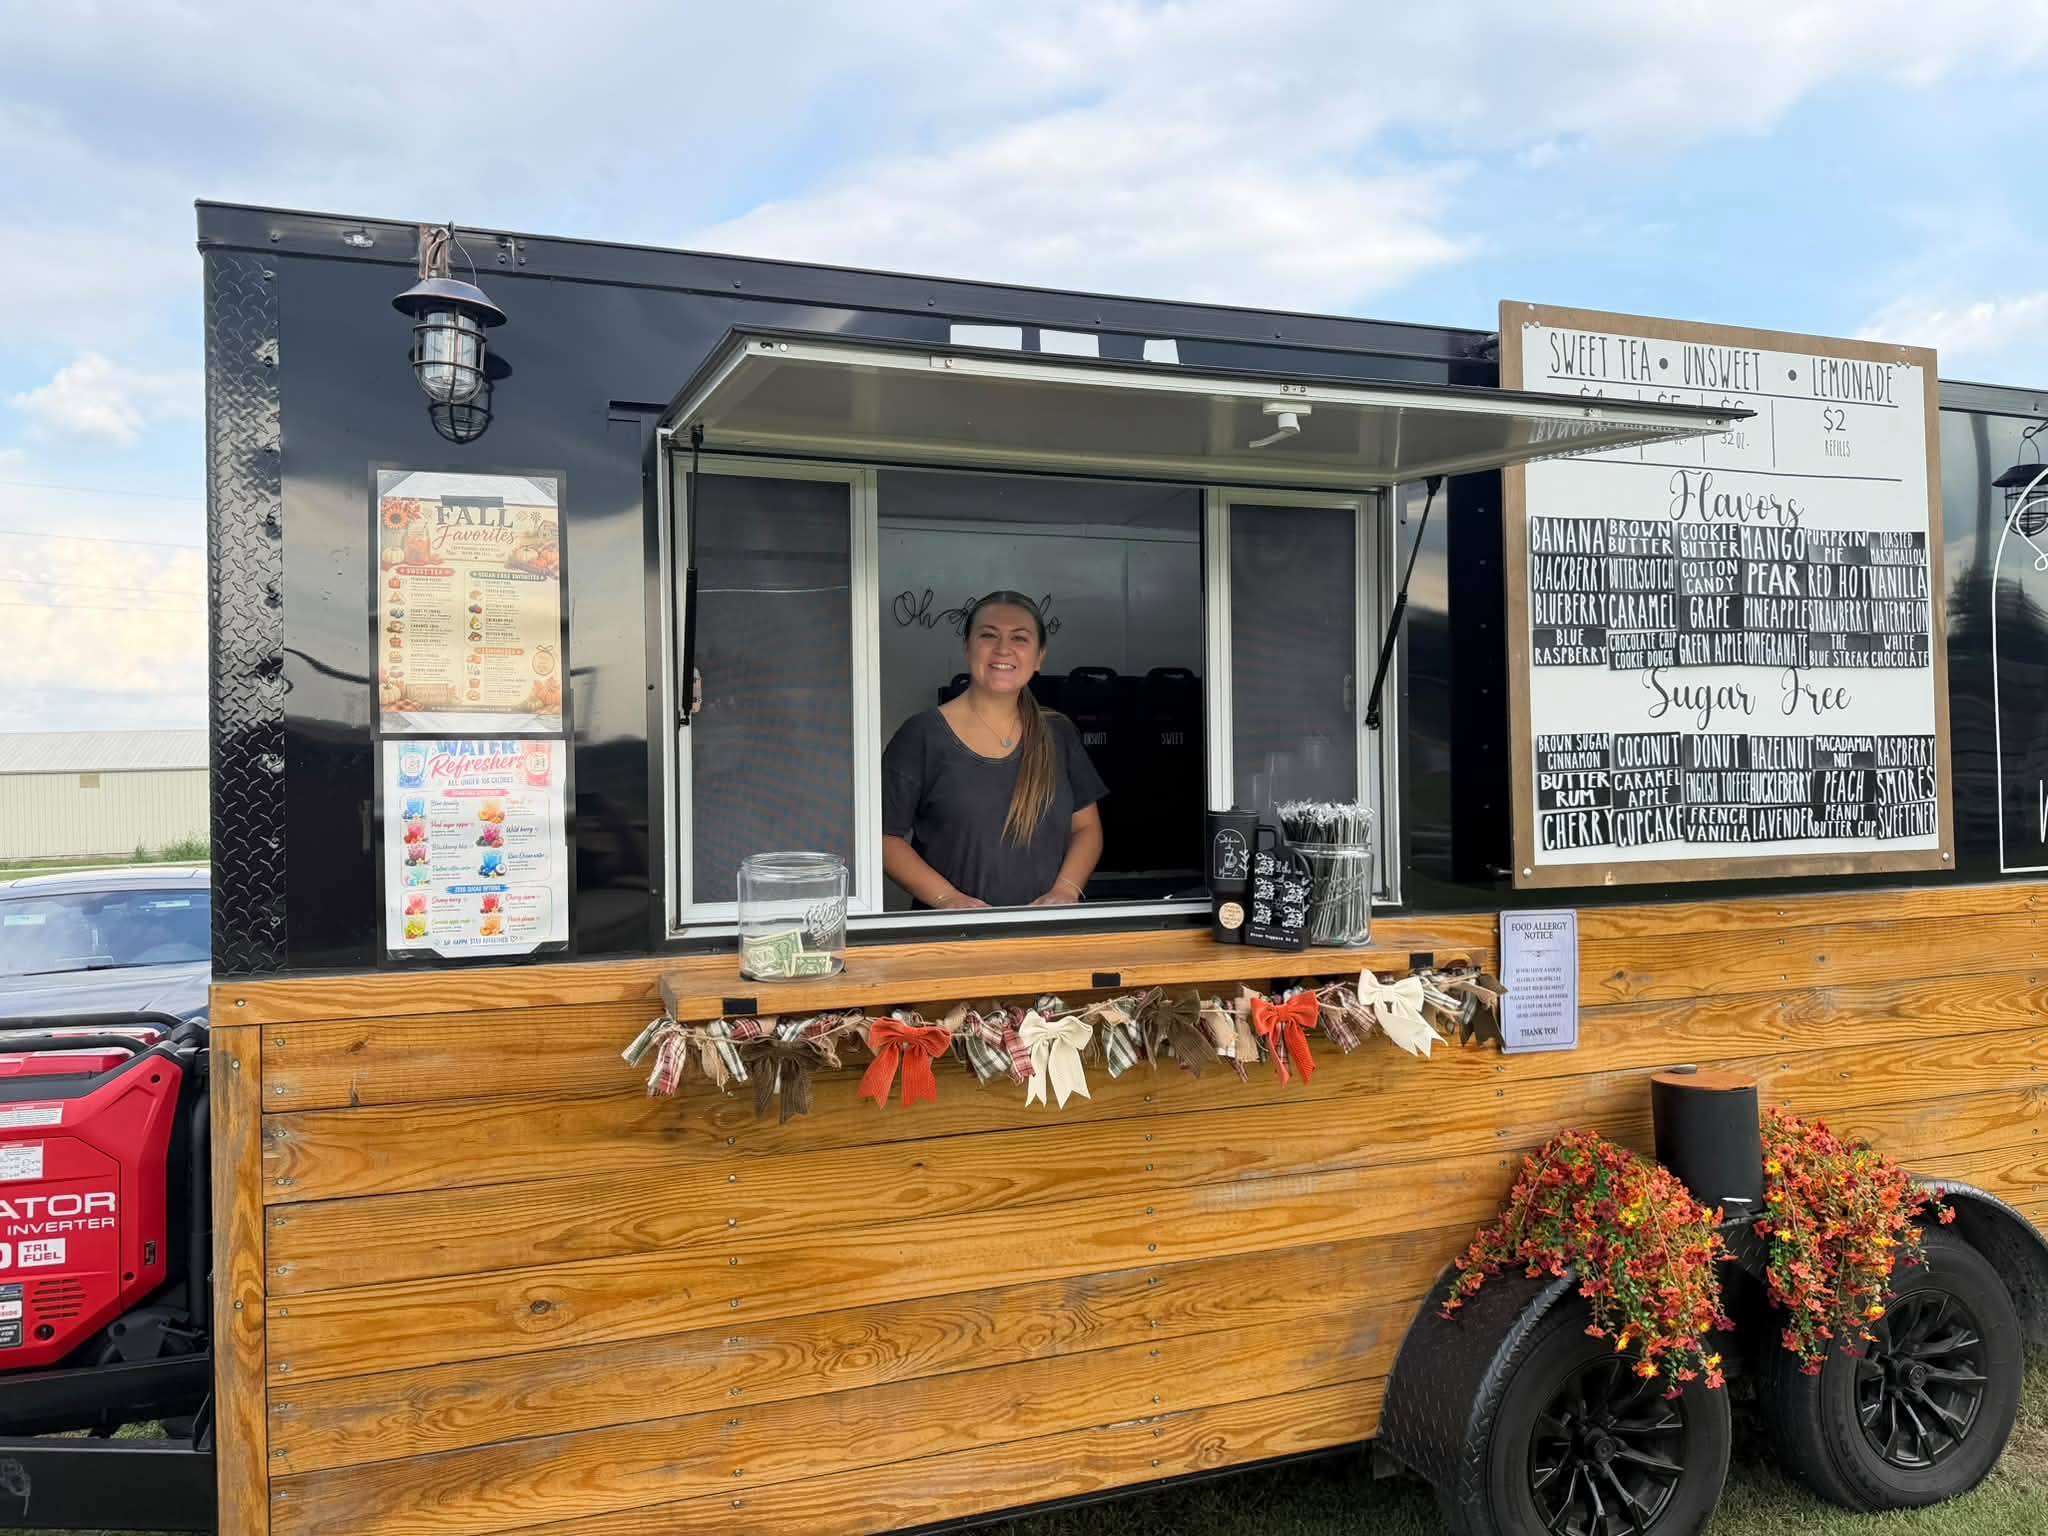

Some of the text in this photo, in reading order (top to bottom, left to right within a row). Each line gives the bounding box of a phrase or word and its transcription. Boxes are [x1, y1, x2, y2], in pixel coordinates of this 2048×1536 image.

[1550, 332, 1652, 382] SWEET TEA
[1683, 345, 1760, 392] UNSWEET
[1812, 357, 1894, 403] LEMONADE
[1823, 406, 1846, 434] $2
[1824, 438, 1851, 458] REFILLS
[1670, 469, 1804, 527] Flavors
[434, 505, 514, 528] FALL
[432, 525, 514, 550] Favorites
[1532, 517, 1605, 554] BANANA
[1609, 521, 1672, 538] BROWN
[1680, 524, 1737, 541] COOKIE
[1807, 530, 1866, 547] PUMPKIN
[1880, 532, 1913, 548] TOASTED
[1608, 537, 1674, 554] BUTTER
[1681, 541, 1740, 558] BUTTER
[1740, 526, 1805, 560] MANGO
[1824, 547, 1843, 563] PIE
[1870, 548, 1926, 565] MARSHMALLOW
[1533, 556, 1608, 591] BLACKBERRY
[1608, 558, 1674, 590] BUTTERSCOTCH
[1682, 560, 1738, 578] COTTON
[1749, 563, 1801, 595] PEAR
[1686, 577, 1734, 594] CANDY
[1808, 565, 1869, 598] RED HOT
[1869, 566, 1928, 598] VANILLA
[1535, 593, 1607, 625] BLUEBERRY
[1609, 594, 1676, 629] CARAMEL
[1690, 596, 1730, 629] GRAPE
[1744, 599, 1808, 629] PINEAPPLE
[1808, 599, 1869, 632] STRAWBERRY
[1870, 600, 1929, 633] WATERMELON
[1556, 629, 1584, 646] BLUE
[1610, 631, 1677, 651] CHOCOLATE CHIP
[1831, 634, 1848, 650] THE
[1883, 634, 1915, 650] WHITE
[1535, 647, 1608, 664] RASPBERRY
[1615, 650, 1674, 669] COOKIE DOUGH
[1679, 633, 1743, 665] GREEN APPLE
[1744, 632, 1808, 666] POMEGRANATE
[1809, 650, 1869, 667] BLUE STREAK
[1871, 650, 1928, 667] CHOCOLATE
[1642, 666, 1852, 731] Sugar Free
[1538, 733, 1609, 752] BROWN SUGAR
[1617, 735, 1680, 767] COCONUT
[1694, 735, 1740, 768] DONUT
[1751, 736, 1814, 770] HAZELNUT
[1815, 736, 1873, 753] MACADAMIA
[1877, 737, 1935, 767] RASPBERRY
[428, 751, 528, 779] Refreshers
[1547, 751, 1600, 770] CINNAMON
[1833, 752, 1853, 768] NUT
[1540, 772, 1611, 790] BUTTER
[1614, 769, 1680, 791] CARAMEL
[1685, 771, 1749, 803] ENGLISH TOFFEE
[1750, 771, 1812, 803] HUCKLEBERRY
[1824, 771, 1864, 803] PEACH
[1876, 767, 1935, 806] SMORES
[1556, 789, 1596, 807] RUM
[1628, 788, 1669, 807] APPLE
[1691, 807, 1747, 825] FRENCH
[1825, 804, 1865, 820] PEANUT
[1878, 803, 1936, 838] SWEETENER
[1544, 808, 1616, 850] CHERRY
[1616, 805, 1684, 847] CUPCAKE
[1687, 825, 1750, 842] VANILLA
[1753, 808, 1815, 840] LAVENDER
[1814, 820, 1877, 837] BUTTER CUP
[1511, 921, 1568, 932] FOOD ALLERGY
[1524, 930, 1554, 940] NOTICE
[1520, 1026, 1558, 1038] THANK YOU
[7, 1217, 115, 1236] INVERTER
[23, 1243, 48, 1253] TRI
[23, 1251, 62, 1263] FUEL
